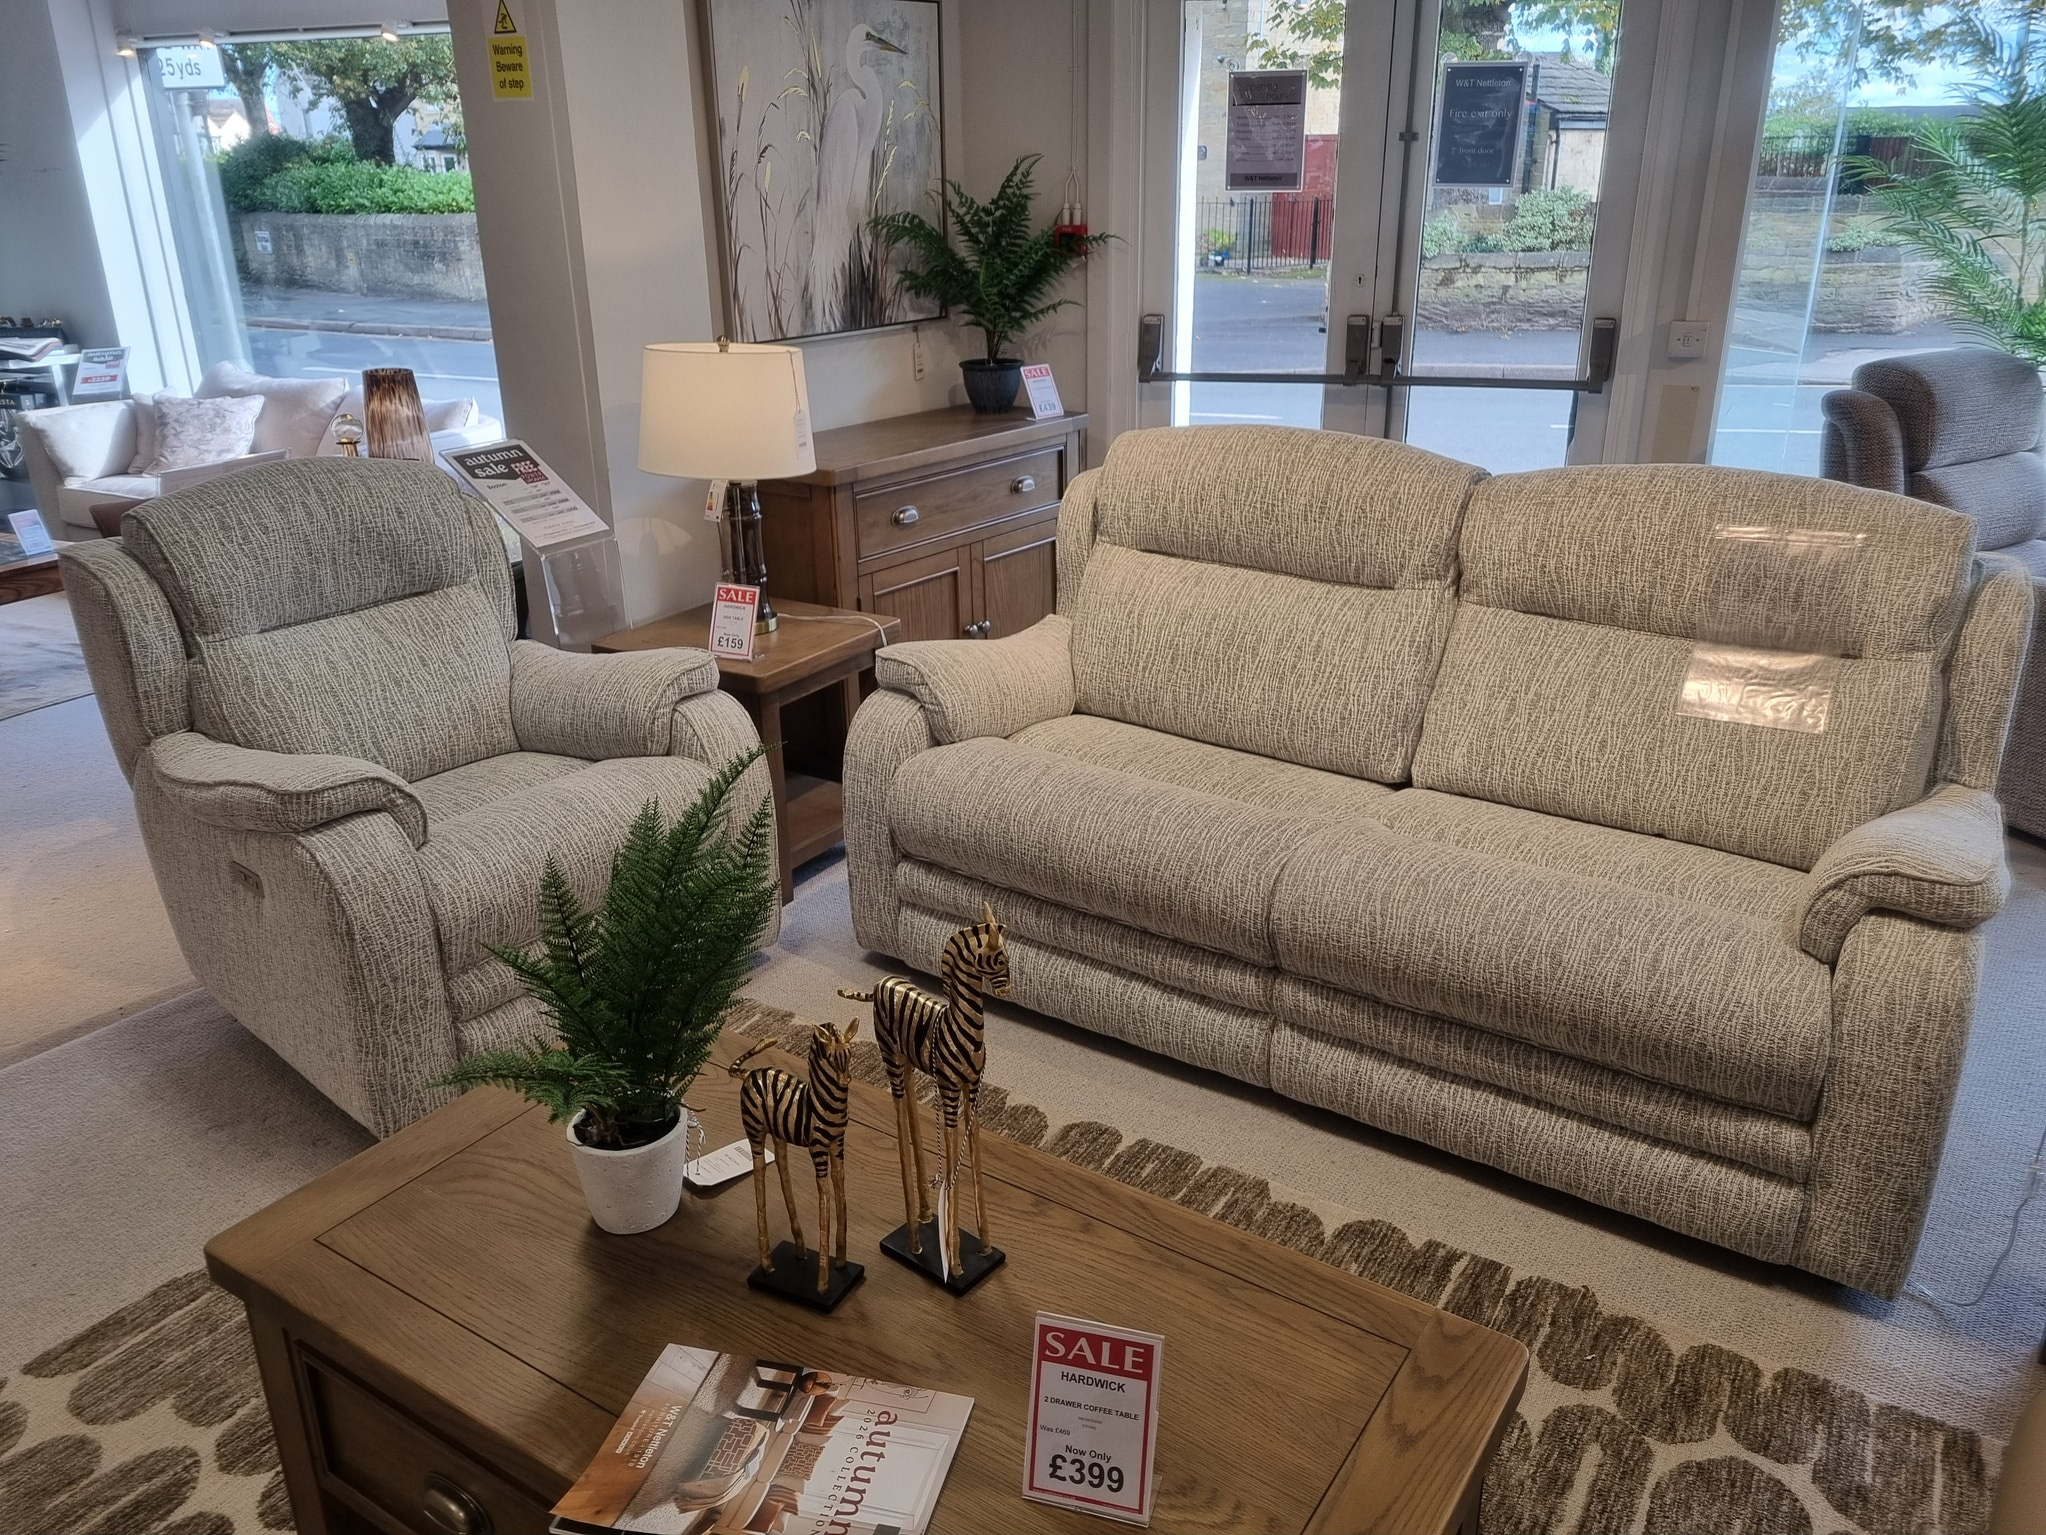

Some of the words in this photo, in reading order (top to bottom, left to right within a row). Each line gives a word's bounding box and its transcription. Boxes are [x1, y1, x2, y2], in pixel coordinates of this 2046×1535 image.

[492, 43, 523, 57] Warning
[496, 61, 523, 72] Beware
[499, 77, 506, 89] of
[508, 78, 524, 91] step
[1455, 79, 1474, 87] W&T
[1476, 78, 1511, 88] Nettleton
[1449, 108, 1468, 118] Fire
[1470, 109, 1488, 118] exit
[1491, 108, 1513, 120] only
[1458, 146, 1476, 155] front
[1478, 146, 1495, 155] door
[1025, 368, 1048, 378] SALE
[464, 449, 524, 466] autumn
[474, 462, 509, 478] sale
[511, 460, 538, 475] FREE
[719, 589, 753, 602] SALE
[717, 636, 743, 649] £159
[1044, 1331, 1145, 1374] SALE
[1061, 1371, 1126, 1394] HARDWICK
[662, 1405, 682, 1427] W&T
[1050, 1396, 1082, 1410] DRAWER
[1083, 1403, 1113, 1416] COFFEE
[1114, 1410, 1140, 1421] TABLE
[855, 1409, 876, 1440] 2026
[1040, 1424, 1054, 1433] Was
[636, 1428, 668, 1469] Nettleton
[1065, 1444, 1087, 1457] Now
[1089, 1450, 1112, 1463] Only
[824, 1410, 898, 1535] autumn
[1048, 1454, 1125, 1494] £399
